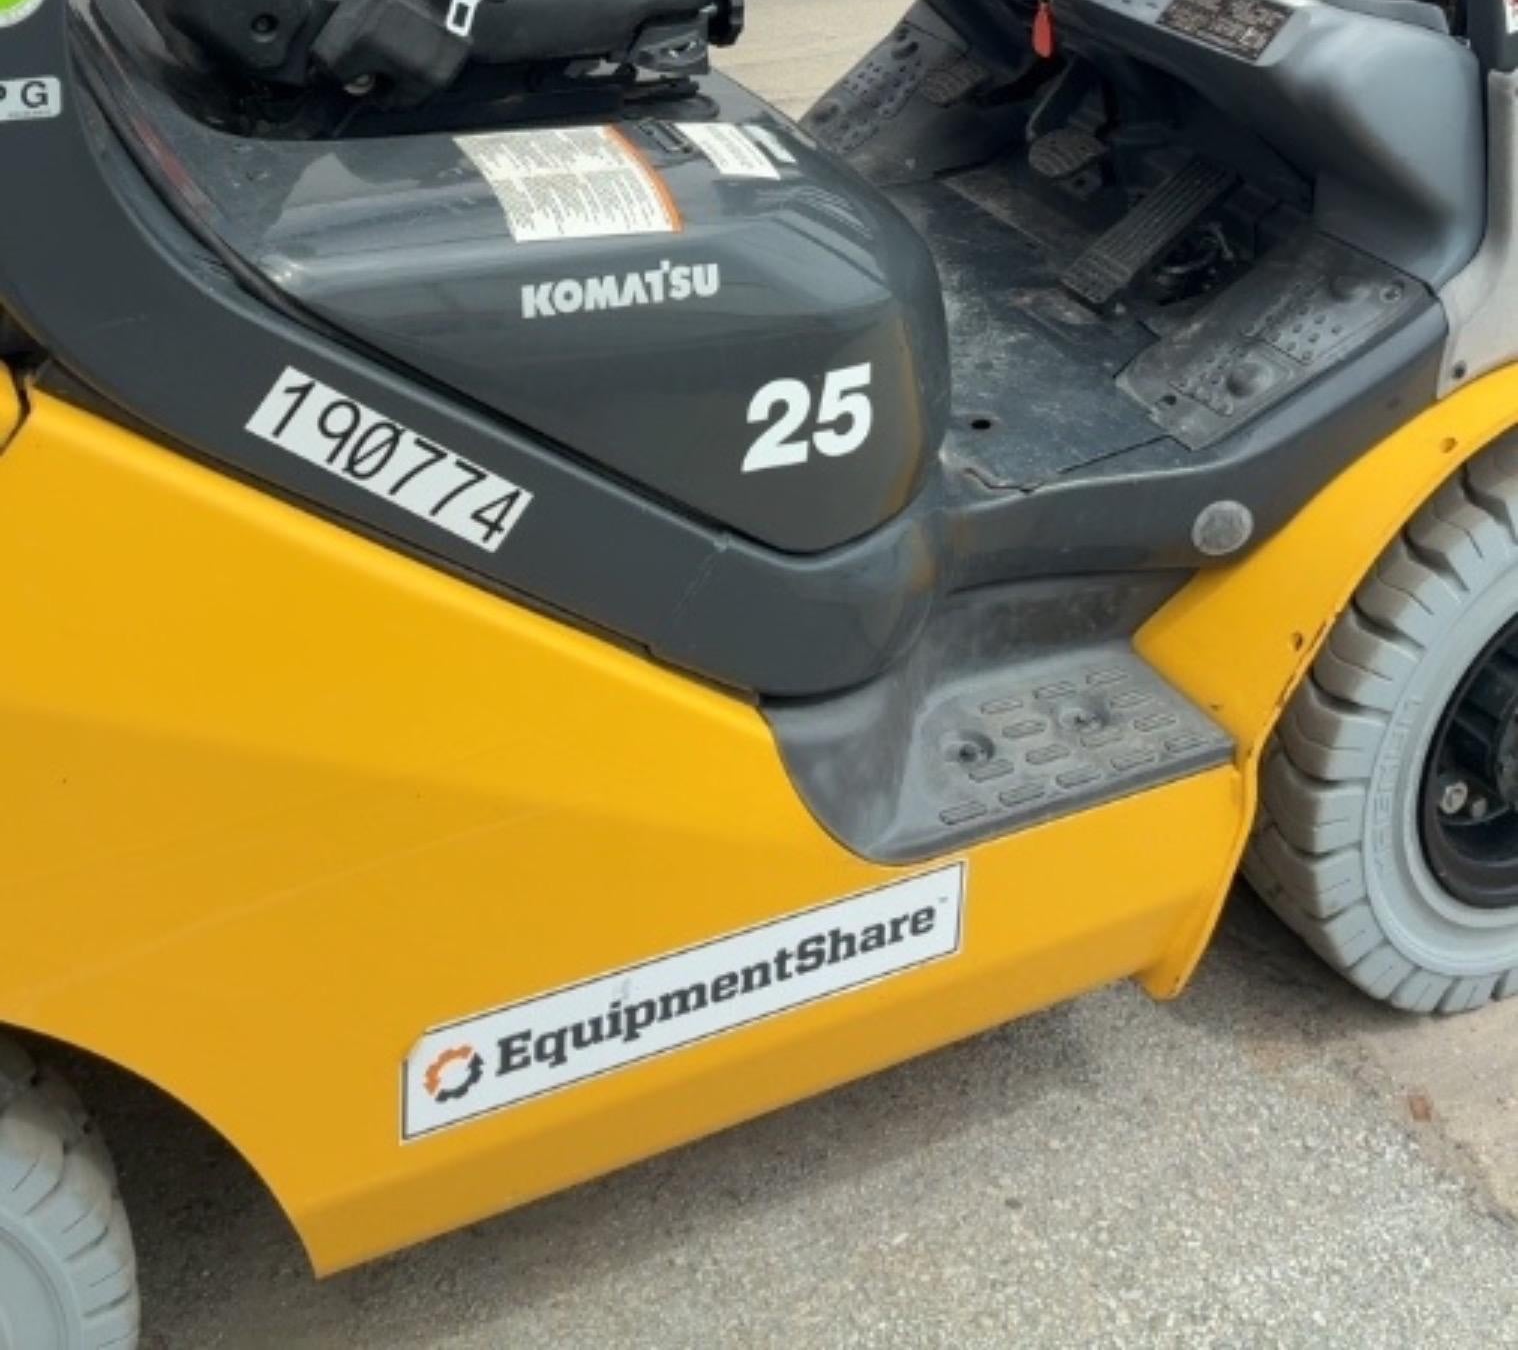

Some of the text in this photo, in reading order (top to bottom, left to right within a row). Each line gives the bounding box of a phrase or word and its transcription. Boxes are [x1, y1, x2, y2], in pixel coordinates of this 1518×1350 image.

[520, 259, 721, 319] KOMATSU
[271, 379, 521, 543] 190774
[741, 361, 873, 474] 25
[496, 904, 936, 1077] EquipmentShare
